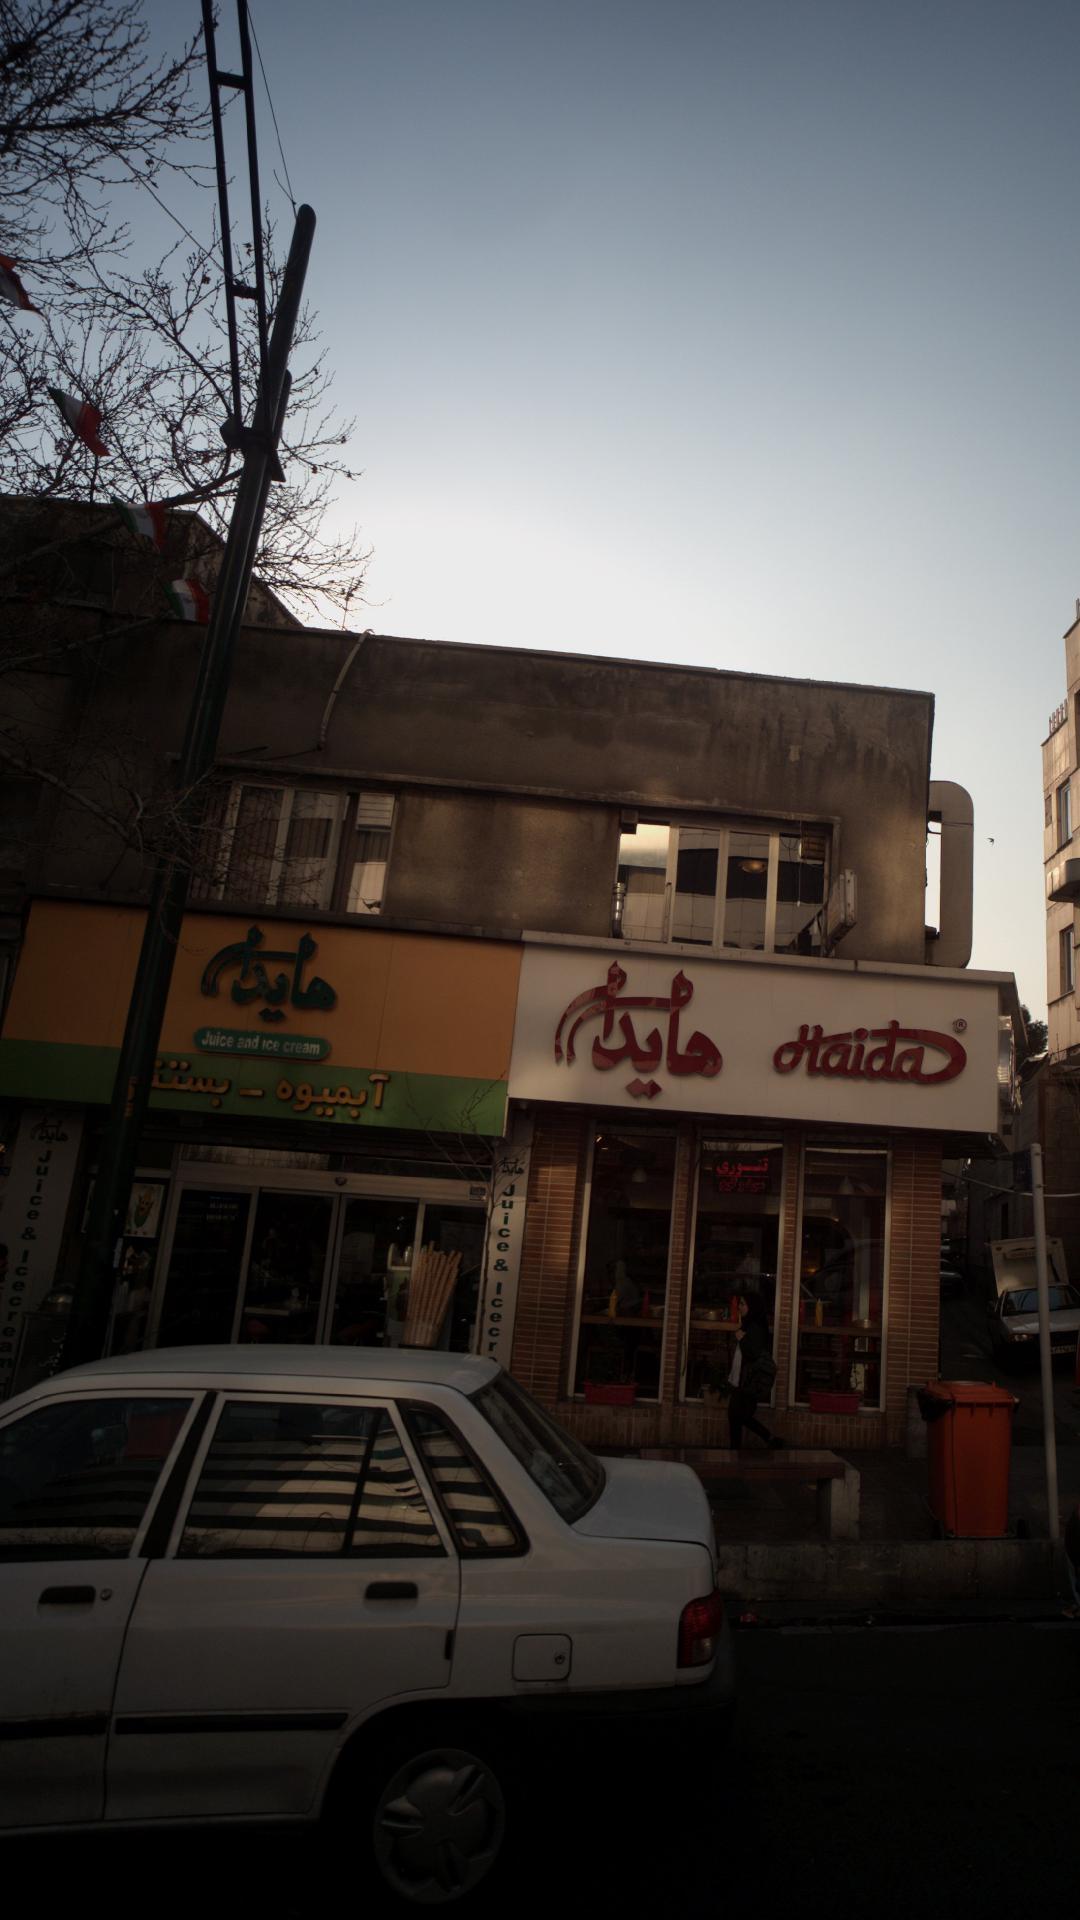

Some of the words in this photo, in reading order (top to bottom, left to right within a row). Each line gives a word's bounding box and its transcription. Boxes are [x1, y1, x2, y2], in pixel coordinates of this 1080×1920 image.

[201, 1031, 233, 1050] Juice
[236, 1034, 260, 1051] and
[282, 1039, 321, 1056] cream
[772, 1019, 967, 1085] Haida
[275, 1072, 391, 1119] آبمیوه
[27, 1151, 52, 1220] Juice
[22, 1227, 36, 1241] &
[497, 1184, 516, 1252] Juice
[493, 1258, 509, 1272] &
